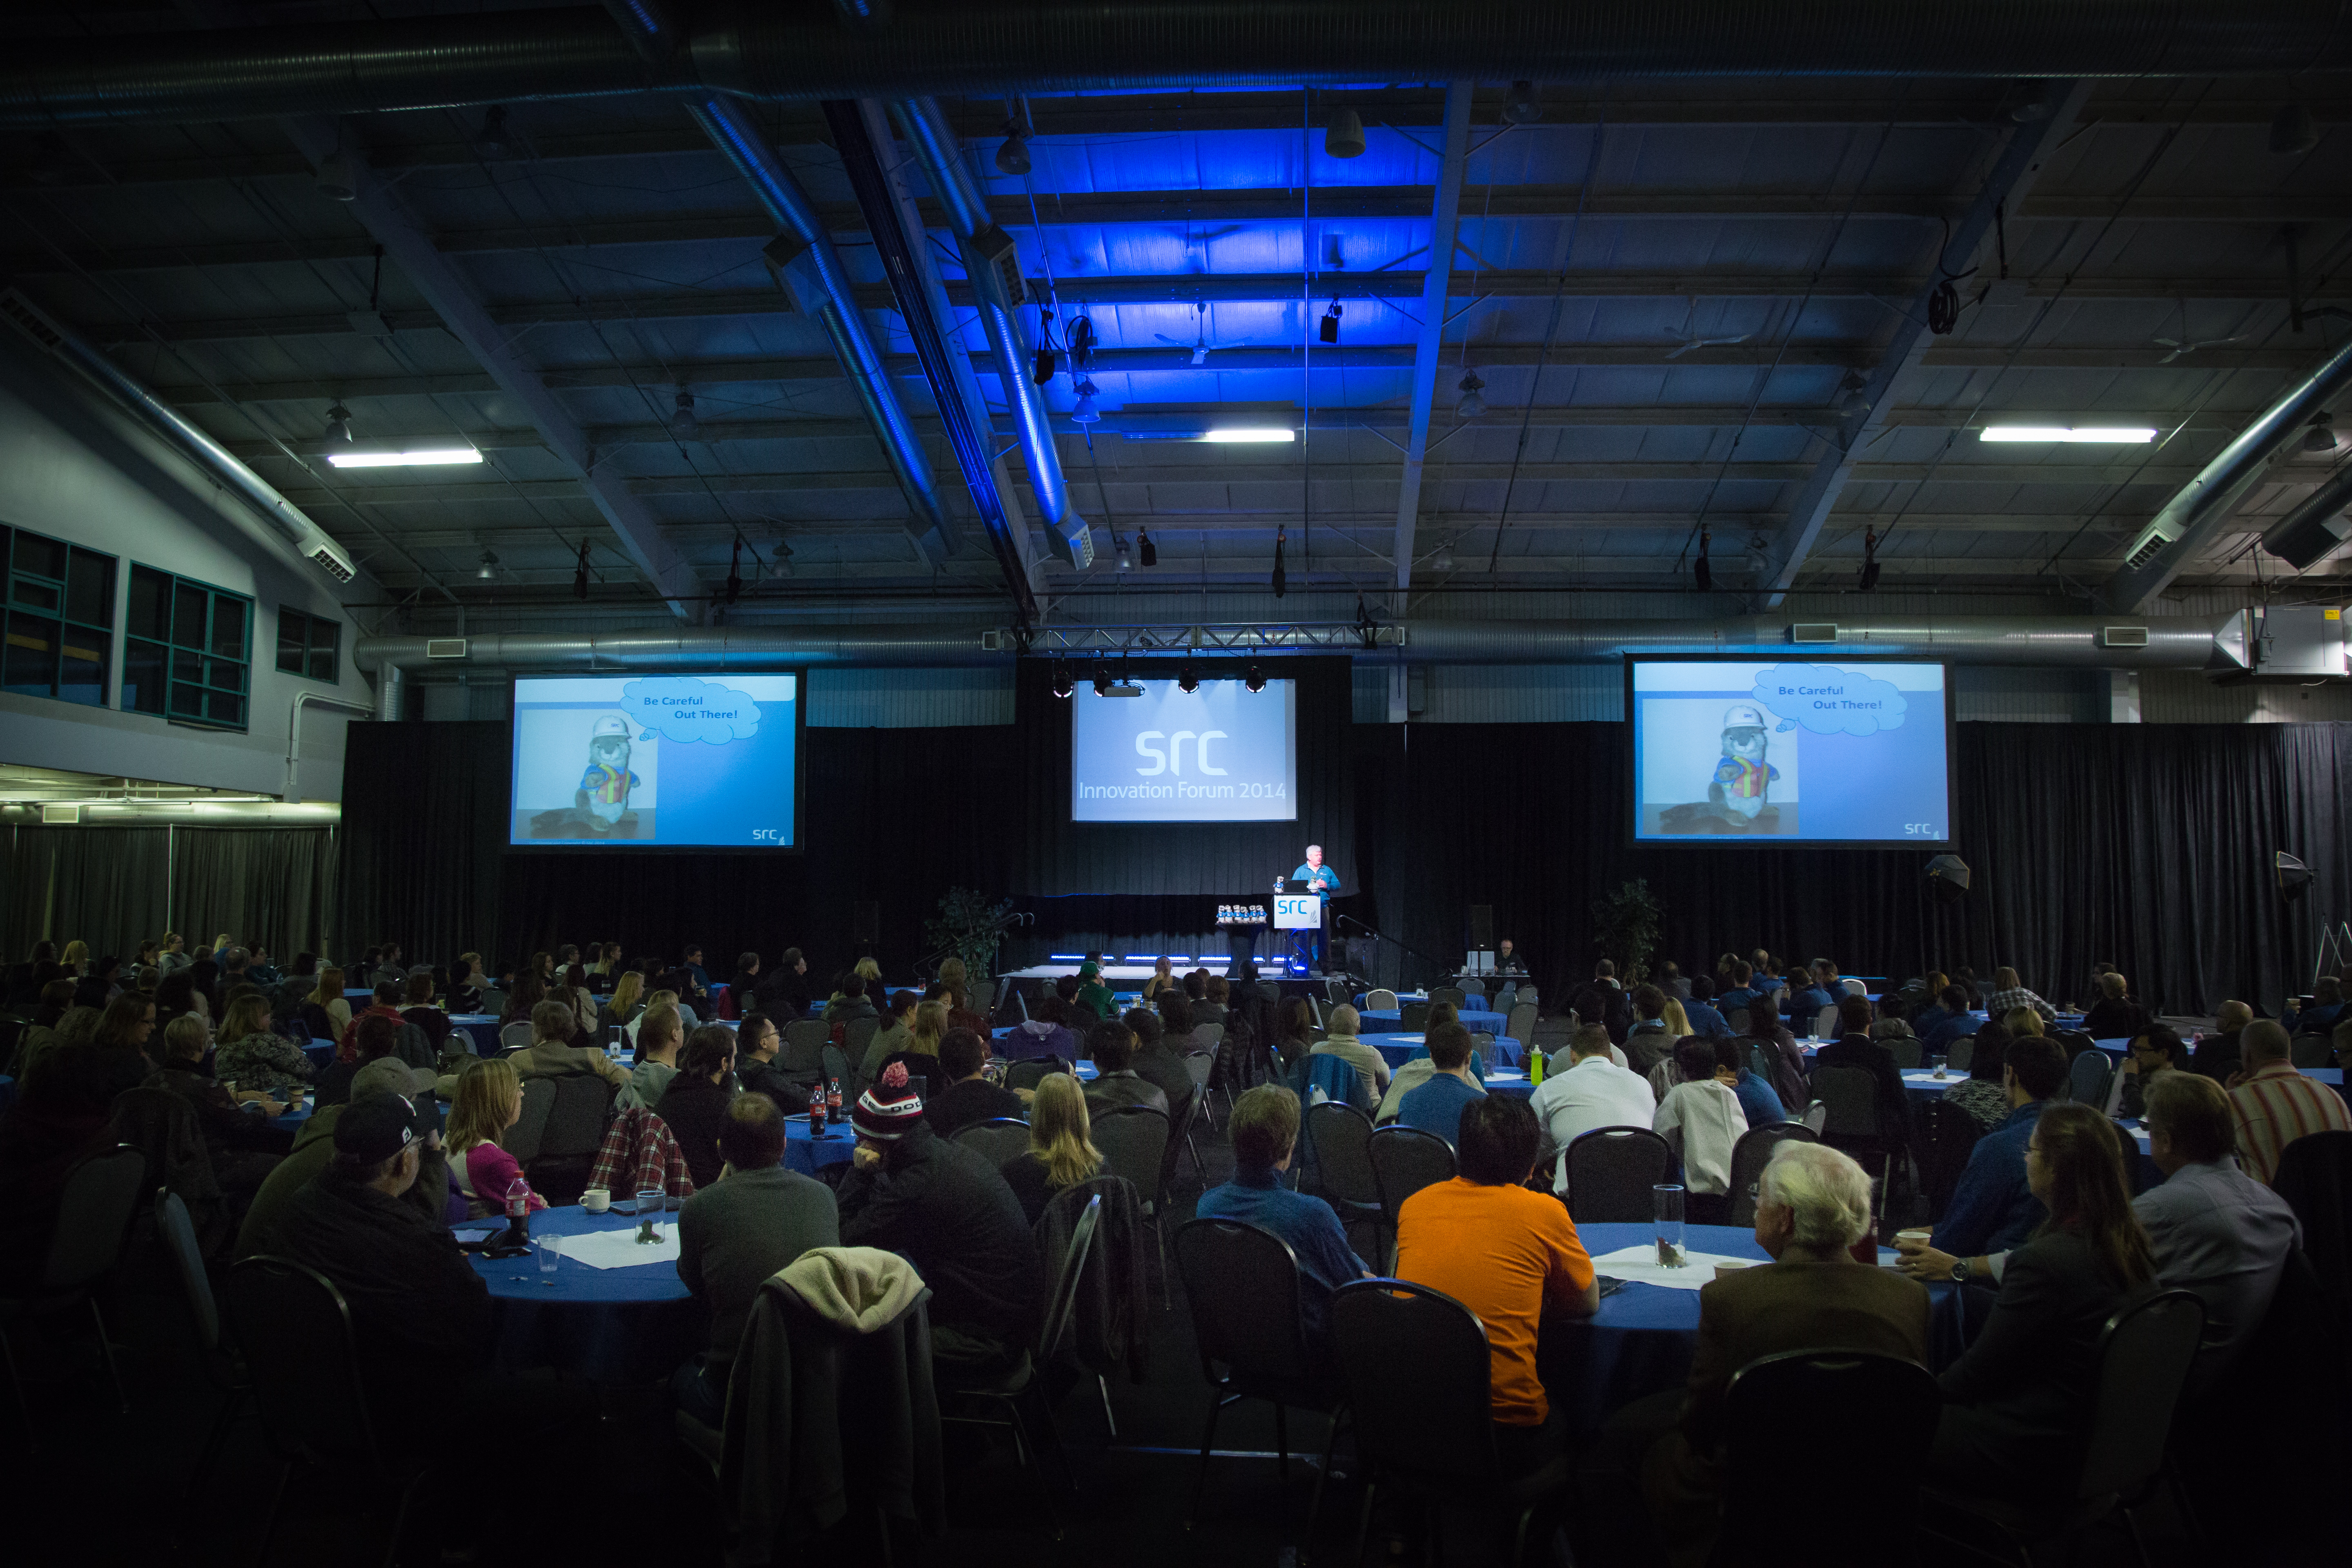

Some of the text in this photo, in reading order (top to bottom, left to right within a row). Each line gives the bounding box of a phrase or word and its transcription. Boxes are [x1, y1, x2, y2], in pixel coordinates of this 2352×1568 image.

[1779, 686, 1844, 695] Be Careful
[644, 697, 703, 706] Be Careful
[1813, 700, 1882, 709] Out There!
[674, 710, 738, 719] Out There!
[1079, 781, 1286, 800] Innovation Forum 2014
